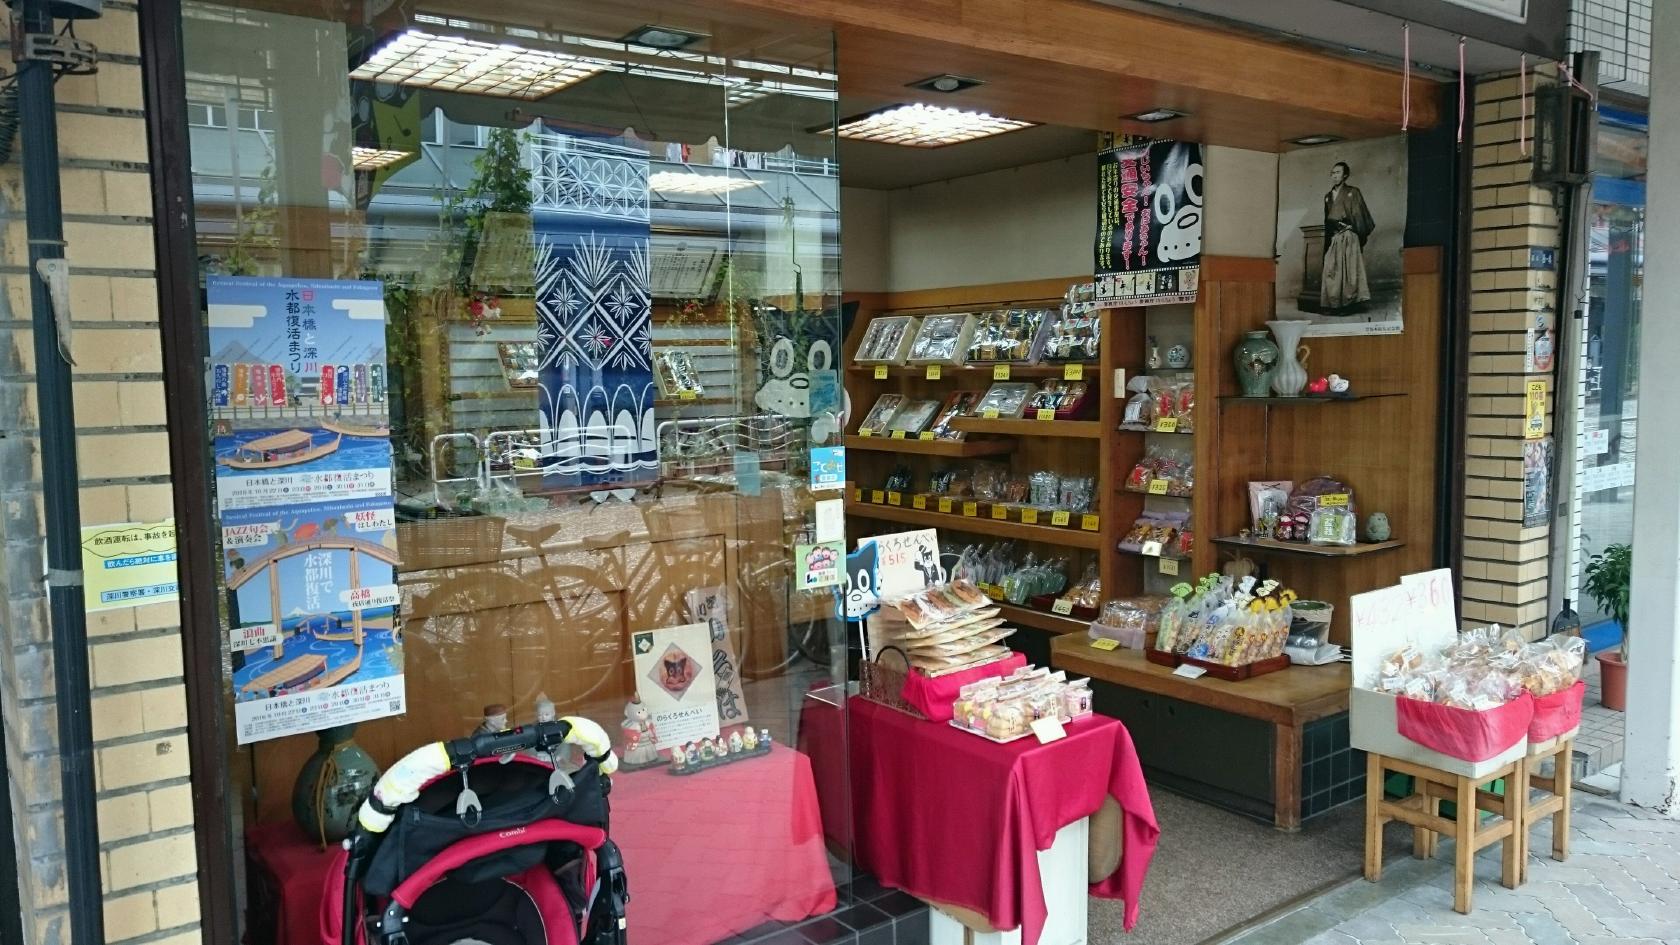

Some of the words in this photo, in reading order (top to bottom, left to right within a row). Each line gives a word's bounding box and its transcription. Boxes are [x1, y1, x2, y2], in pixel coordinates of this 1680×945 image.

[285, 289, 301, 374] 水都復活まつり
[302, 290, 318, 374] 日本橋と深川
[246, 477, 293, 487] 日本橋と深川
[319, 551, 334, 594] 深川で
[304, 552, 320, 610] 水都復活
[106, 584, 177, 600] 深川警察署・深川交
[265, 696, 311, 711] 日本橋と深川
[656, 708, 703, 722] のらくろせんべい
[499, 826, 526, 838] Combi
